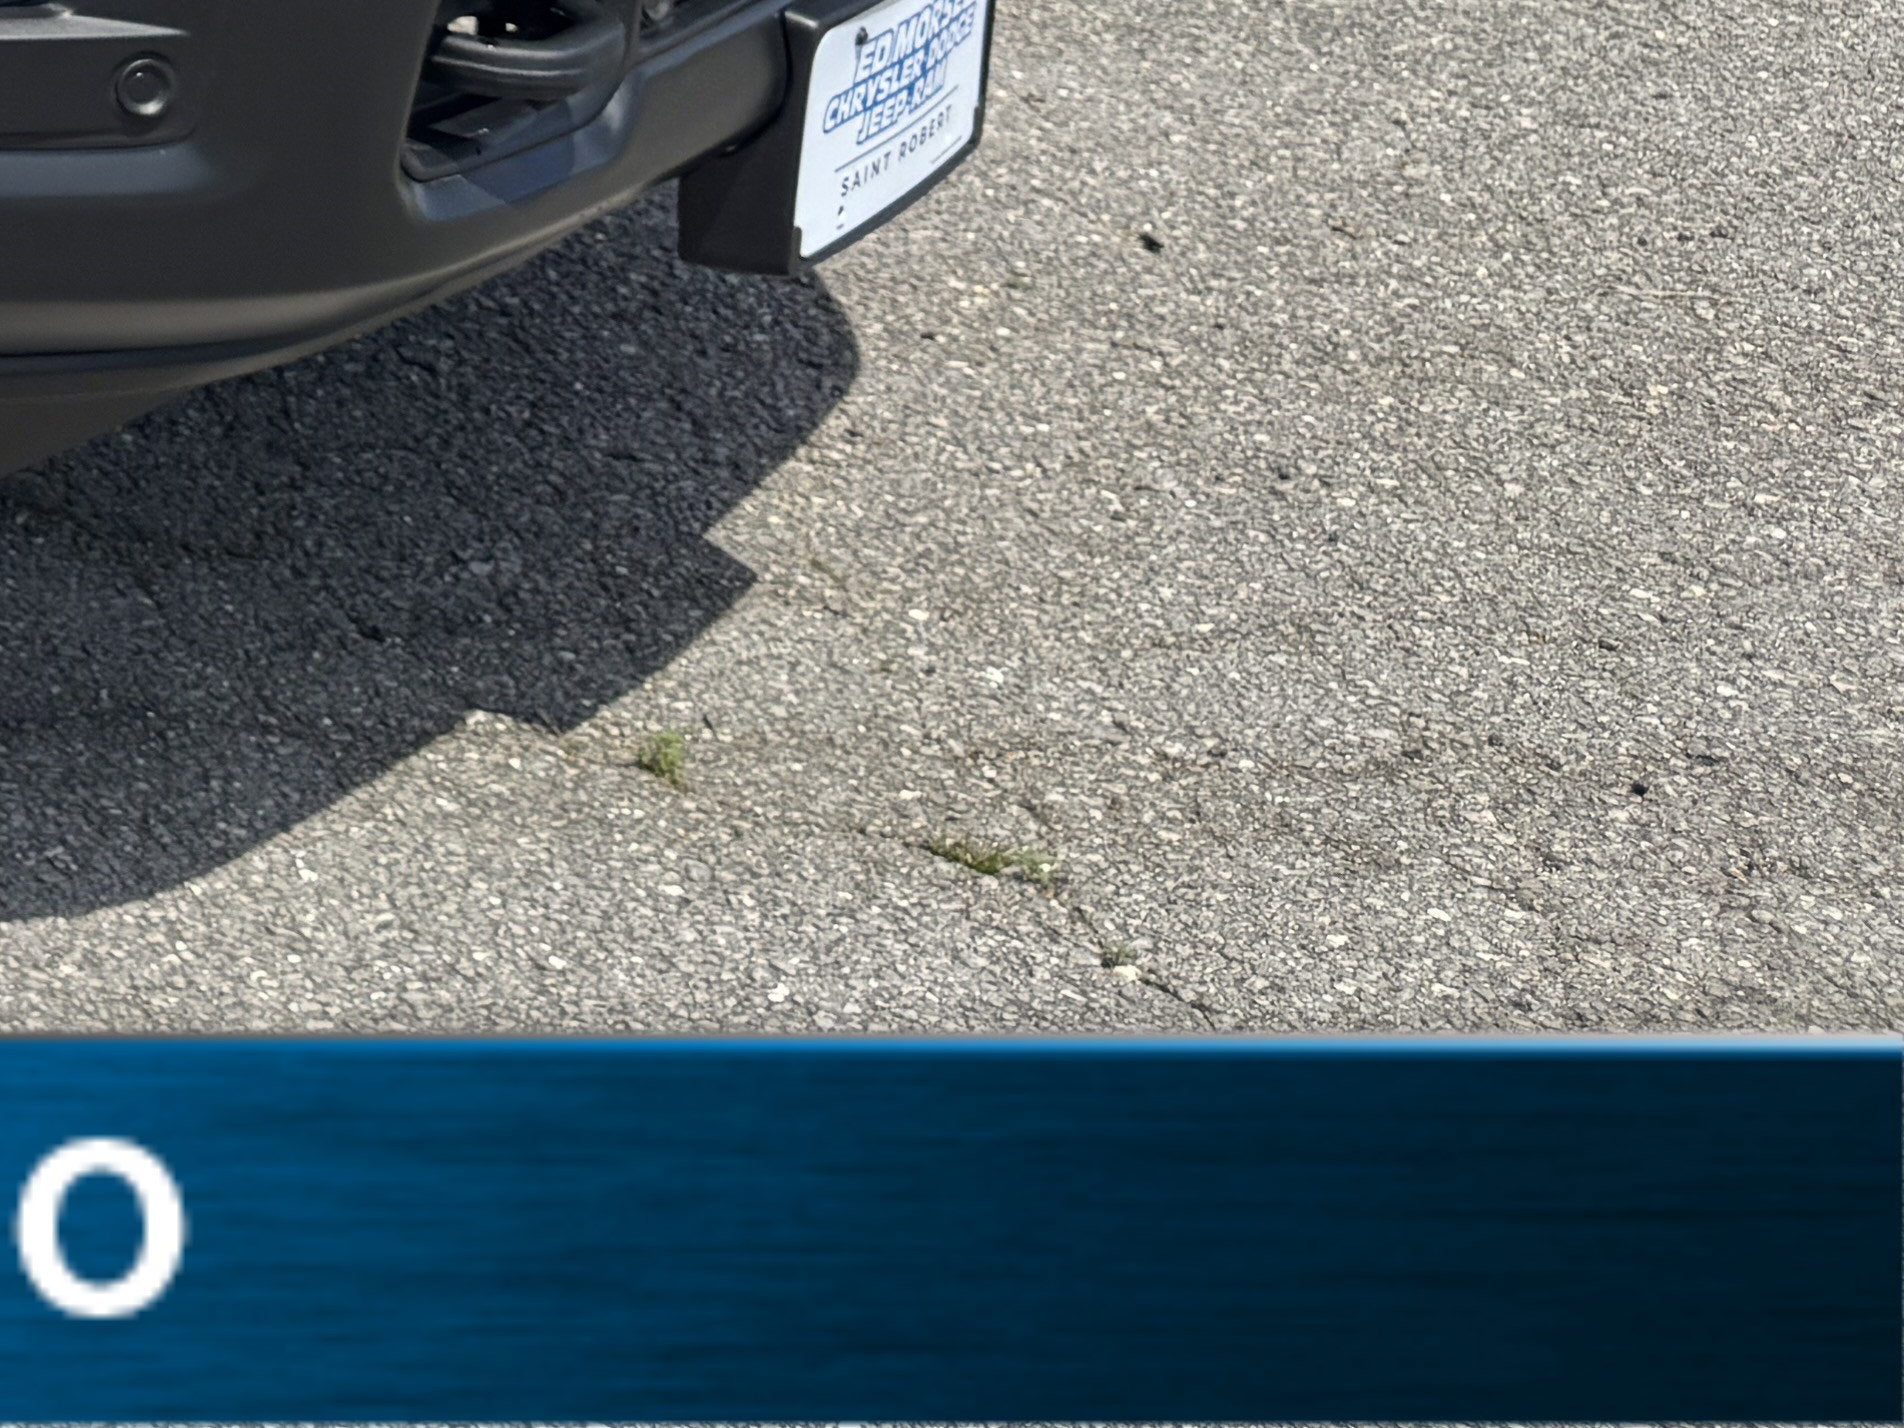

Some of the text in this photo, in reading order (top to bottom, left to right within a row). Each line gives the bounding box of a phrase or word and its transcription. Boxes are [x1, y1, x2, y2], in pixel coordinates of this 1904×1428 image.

[823, 43, 928, 134] CHRYSLER
[853, 28, 896, 84] ED
[840, 103, 953, 197] SAINT ROBERT
